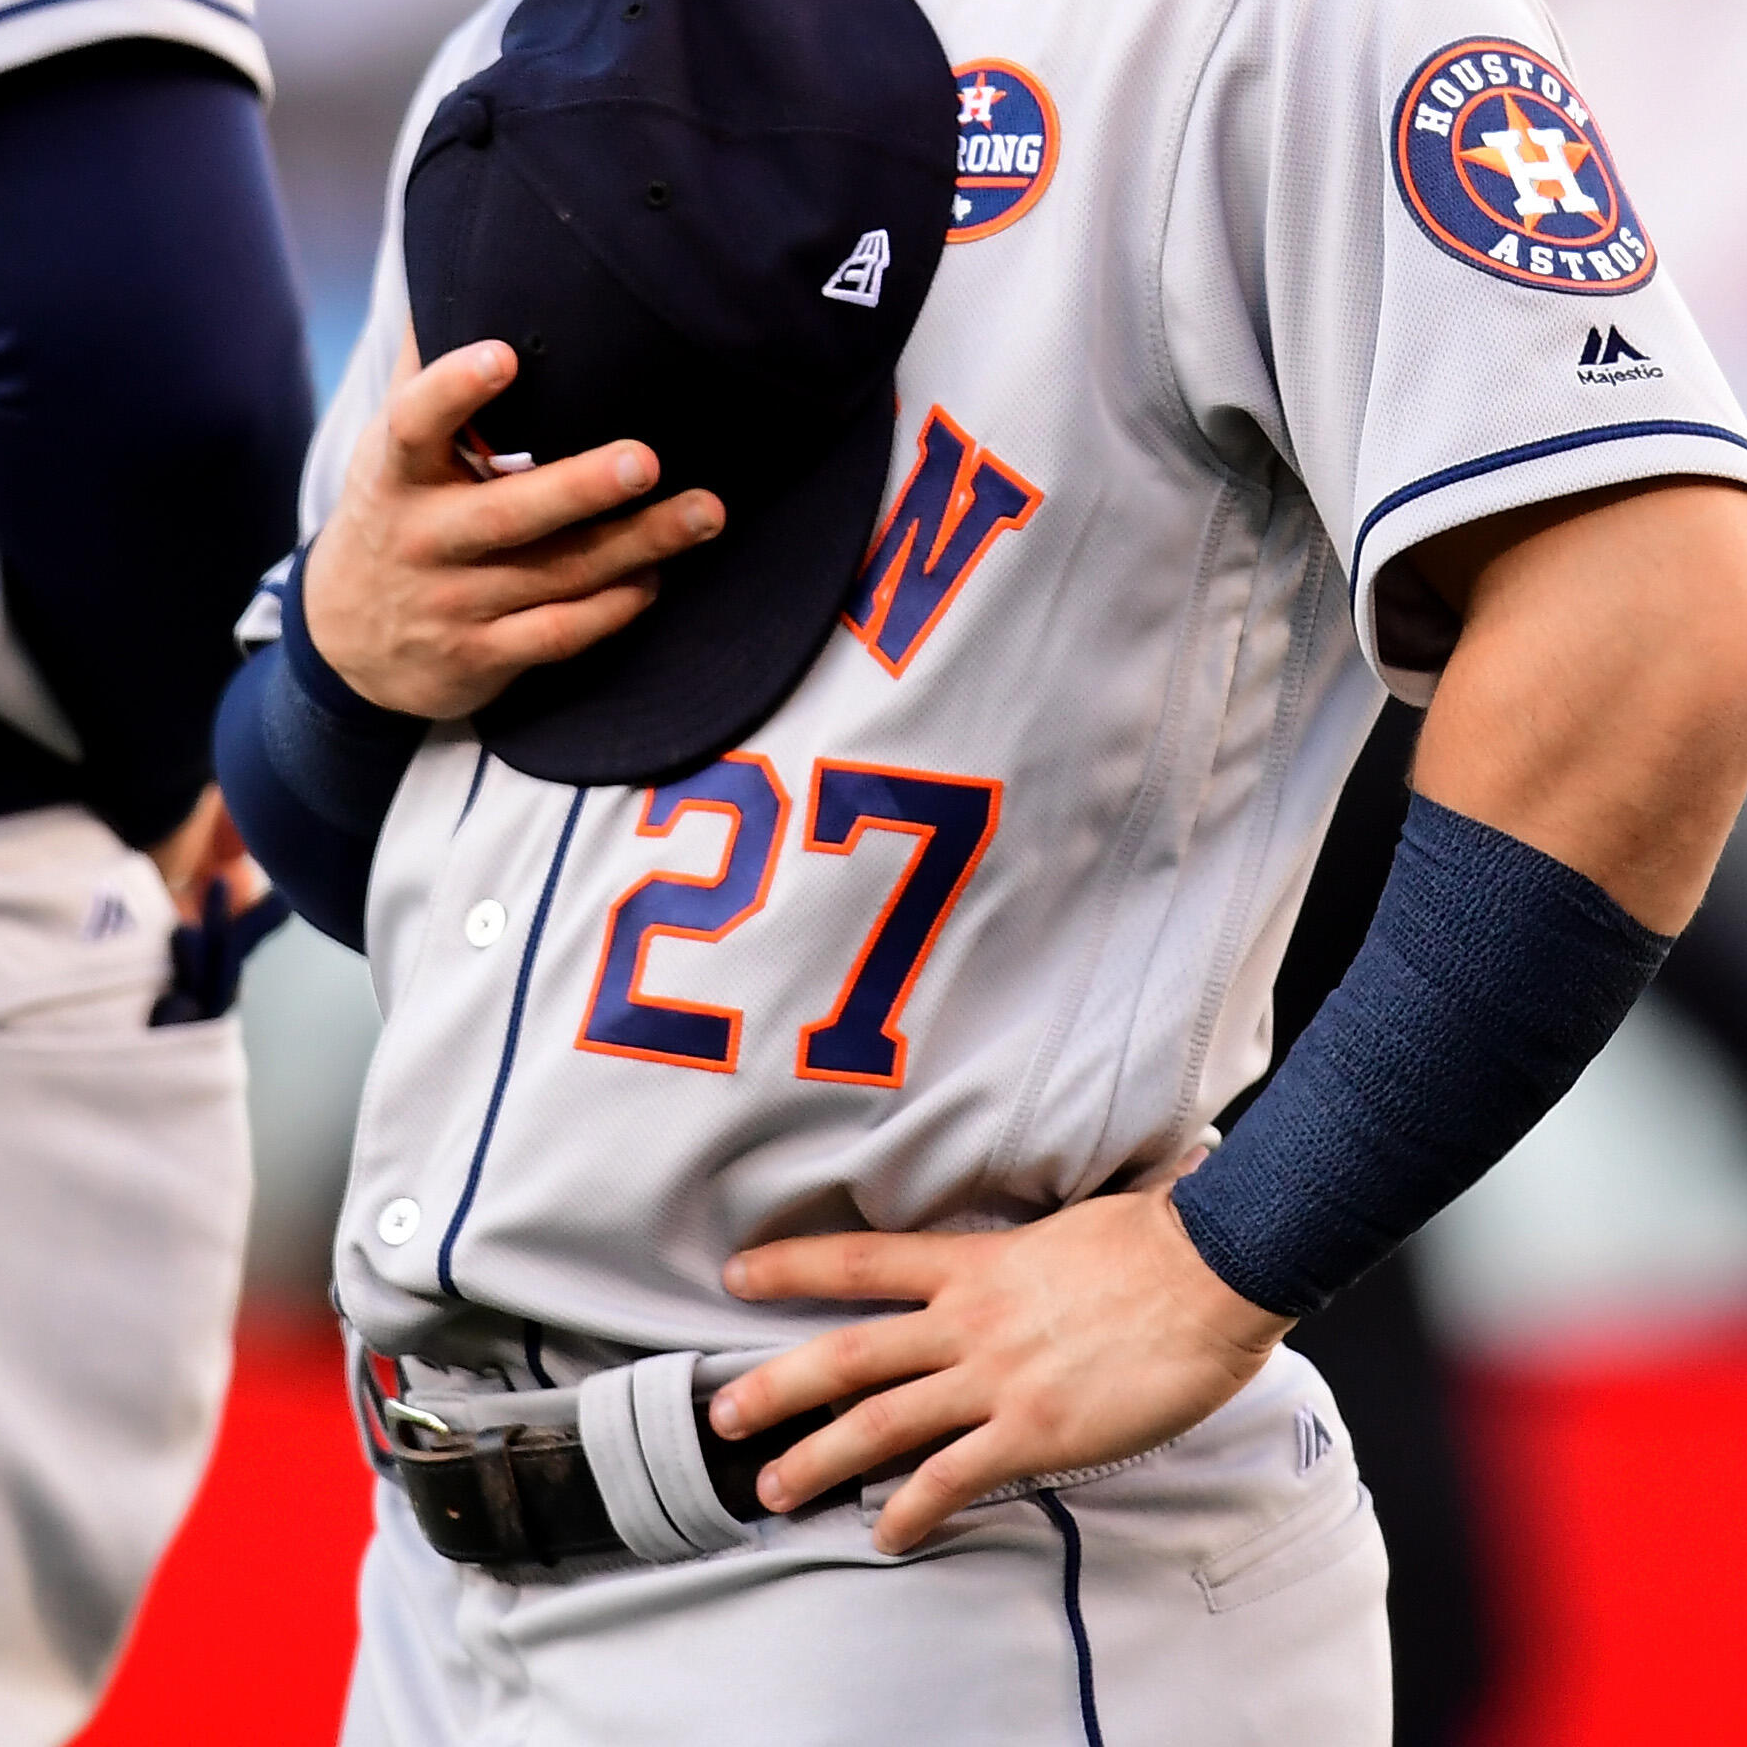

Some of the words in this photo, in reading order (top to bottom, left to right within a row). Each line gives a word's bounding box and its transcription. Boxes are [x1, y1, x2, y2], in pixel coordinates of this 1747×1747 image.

[1415, 53, 1589, 137] HOUSTON
[1480, 128, 1601, 216] H
[1487, 226, 1647, 282] ASTROS
[1576, 364, 1664, 387] Majestic
[572, 749, 1005, 1090] 27
